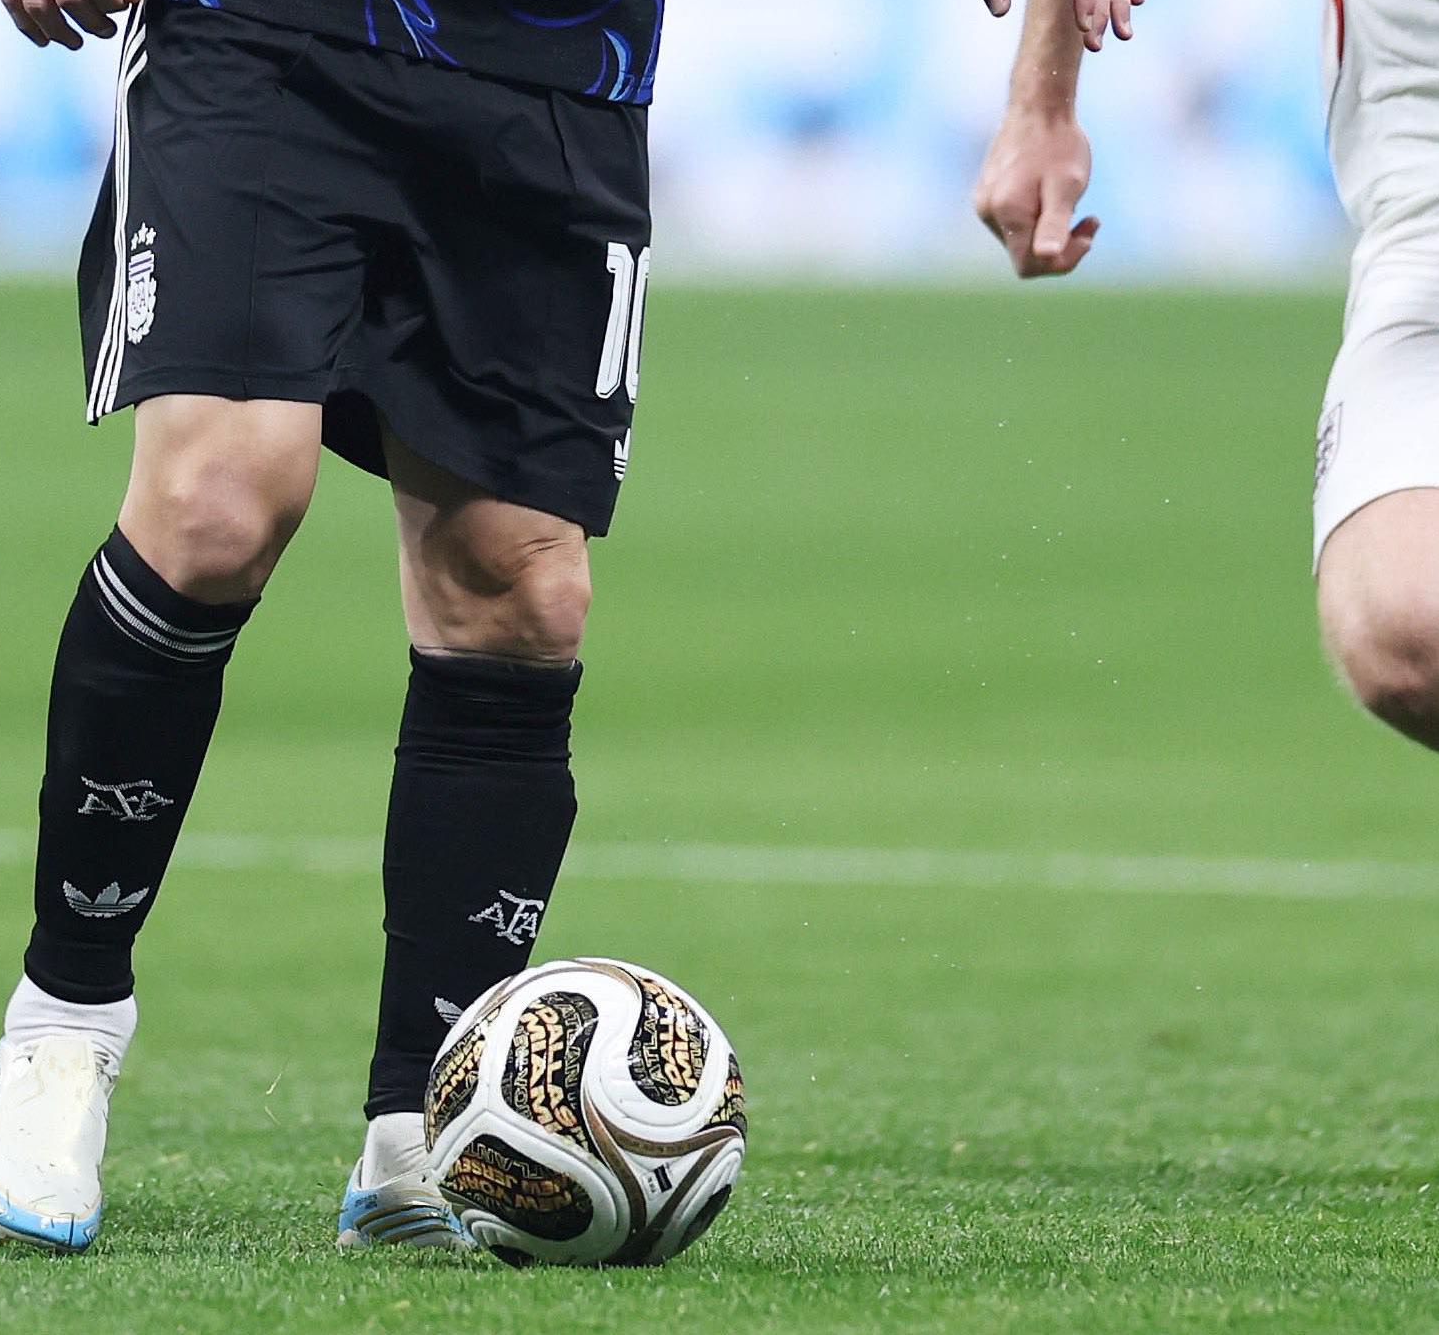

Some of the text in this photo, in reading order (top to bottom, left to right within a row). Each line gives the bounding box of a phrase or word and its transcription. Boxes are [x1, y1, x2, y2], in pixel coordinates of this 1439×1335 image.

[77, 775, 174, 821] AFA
[468, 889, 545, 945] AFA
[519, 1012, 563, 1133] MIAMI
[536, 1006, 578, 1128] DALLAS
